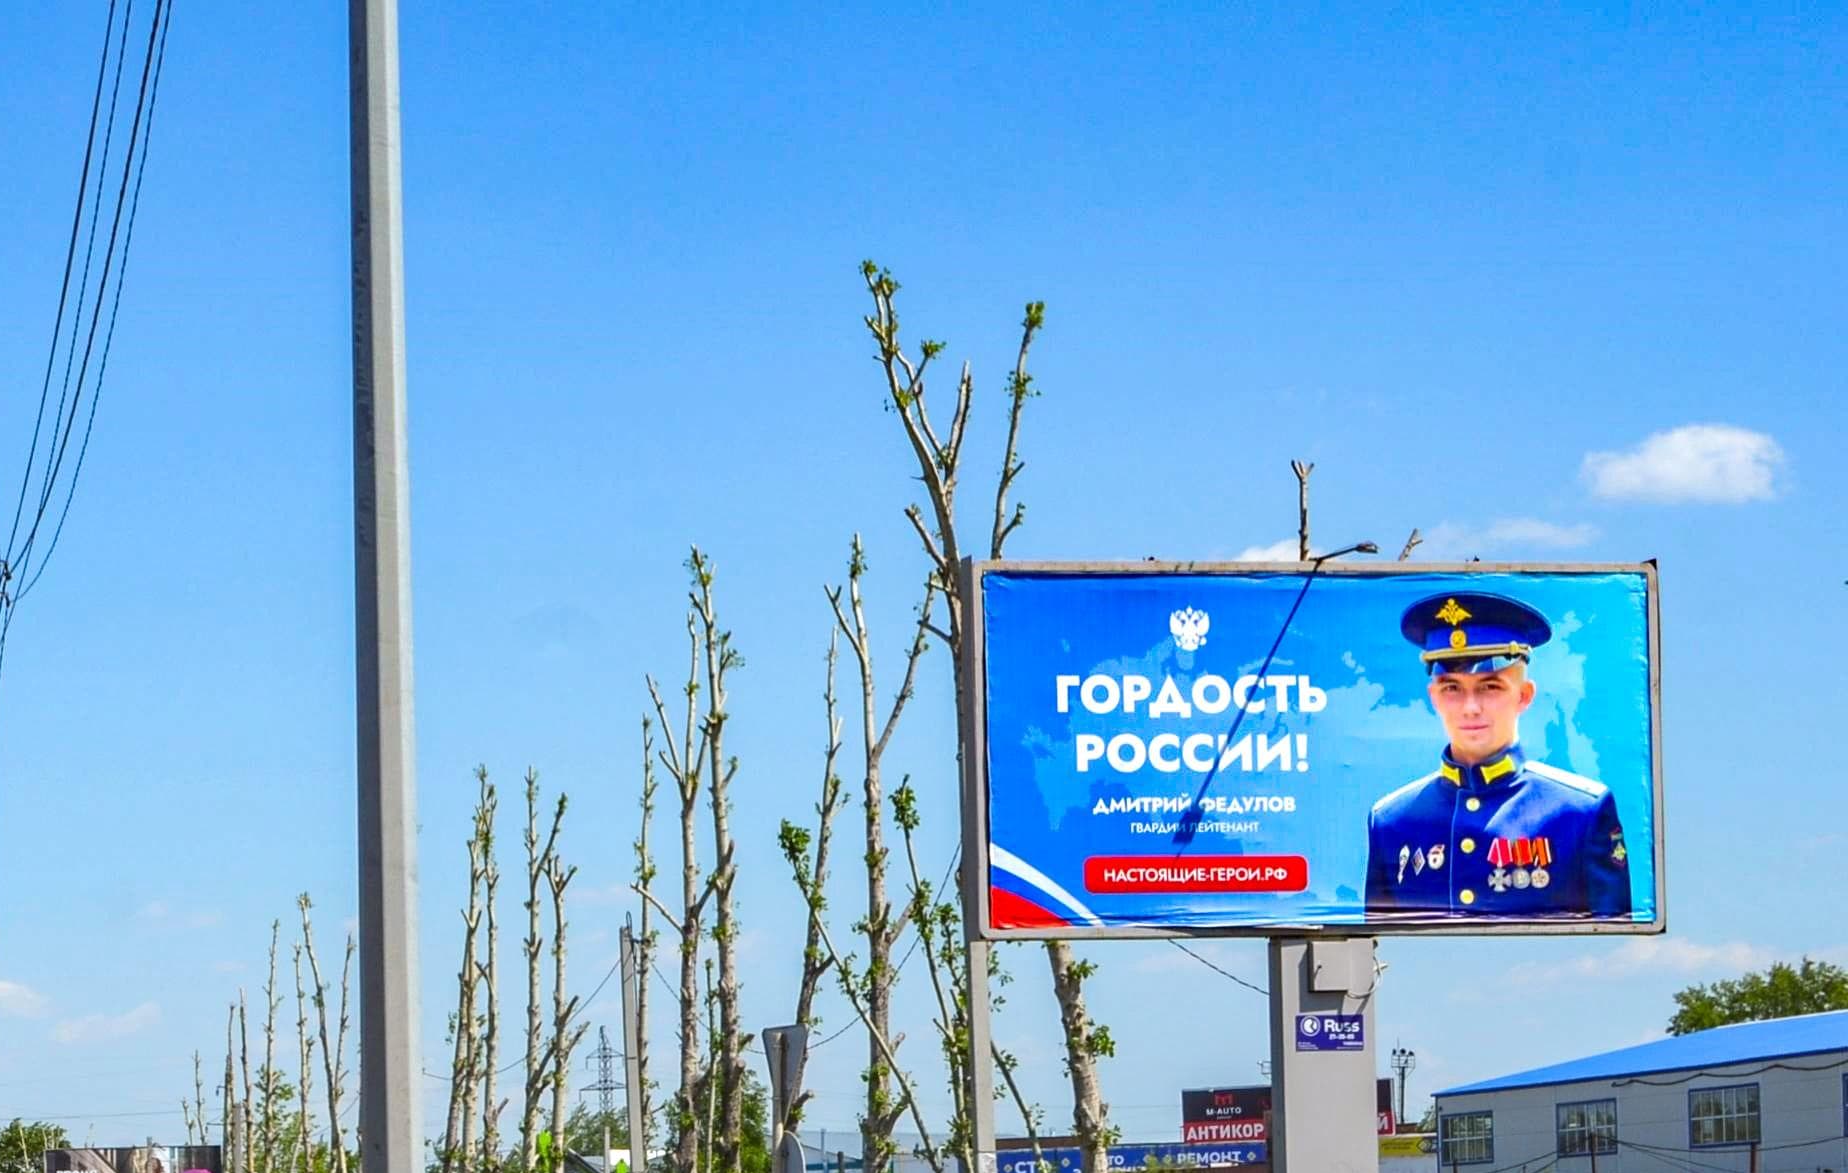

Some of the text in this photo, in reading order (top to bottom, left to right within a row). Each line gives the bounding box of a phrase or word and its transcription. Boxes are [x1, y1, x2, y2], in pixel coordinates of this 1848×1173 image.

[1055, 674, 1328, 719] ГОРДОСТЬ
[1075, 733, 1310, 773] РОССИИ!
[1092, 793, 1297, 815] ДМИТРИЙ ФЕДУЛОВ
[1103, 867, 1288, 884] НАСТОЯЩИЕ-ГЕРОИ.РФ
[1323, 1018, 1361, 1034] Russ
[1186, 1123, 1265, 1142] АНТИКОР
[1176, 1151, 1242, 1165] РЕМОНТ
